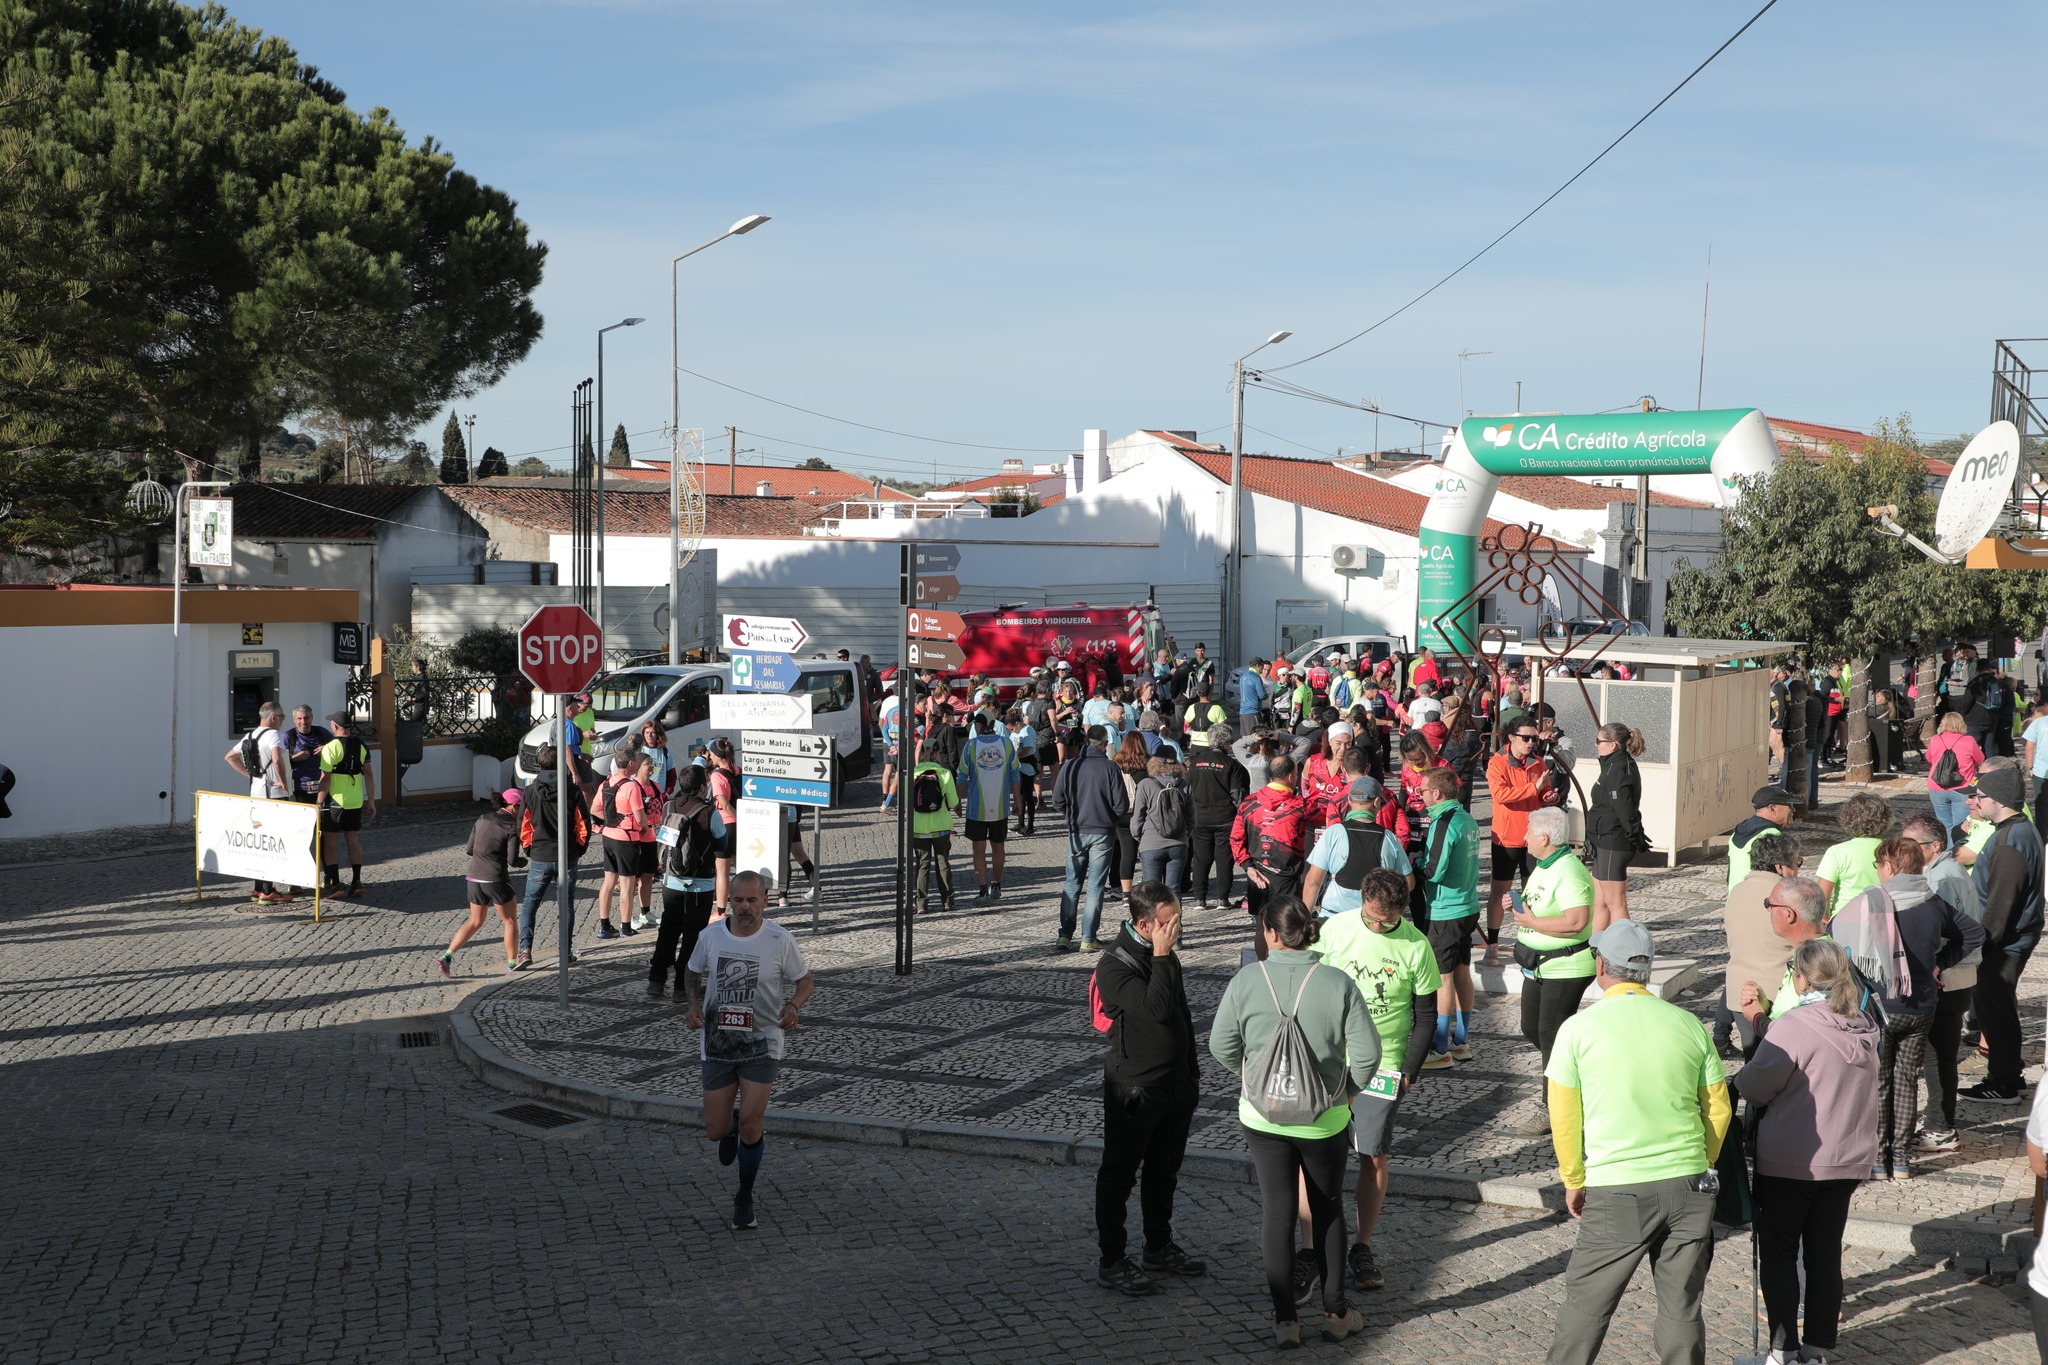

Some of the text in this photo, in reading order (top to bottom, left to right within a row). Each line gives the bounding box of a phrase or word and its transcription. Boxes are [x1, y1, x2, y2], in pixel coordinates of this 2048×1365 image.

[1518, 422, 1706, 452] CA Crédito Agrícola
[1519, 455, 1708, 469] O Banco nacional com pronúncia local
[1961, 450, 2008, 482] meo
[1446, 478, 1467, 492] CA
[210, 552, 230, 565] FRADES
[1430, 545, 1454, 561] CA
[996, 617, 1092, 626] BOMBEIROS VIDIGUEIRA
[339, 633, 357, 648] MB
[773, 633, 794, 643] Uvas
[526, 634, 598, 666] STOP
[241, 657, 260, 665] ATM
[755, 654, 783, 665] HERDADE
[763, 667, 775, 677] DAS
[753, 679, 785, 691] SESMARIAS
[720, 700, 786, 708] CELLA VINARIA
[747, 709, 787, 717] ANTIQUA
[743, 737, 792, 748] Igreja Matriz
[743, 755, 791, 766] Largo Fialho
[756, 765, 787, 775] Almeida
[775, 785, 828, 798] Posto Médico
[1382, 957, 1400, 967] SERPA
[724, 1014, 745, 1025] 263
